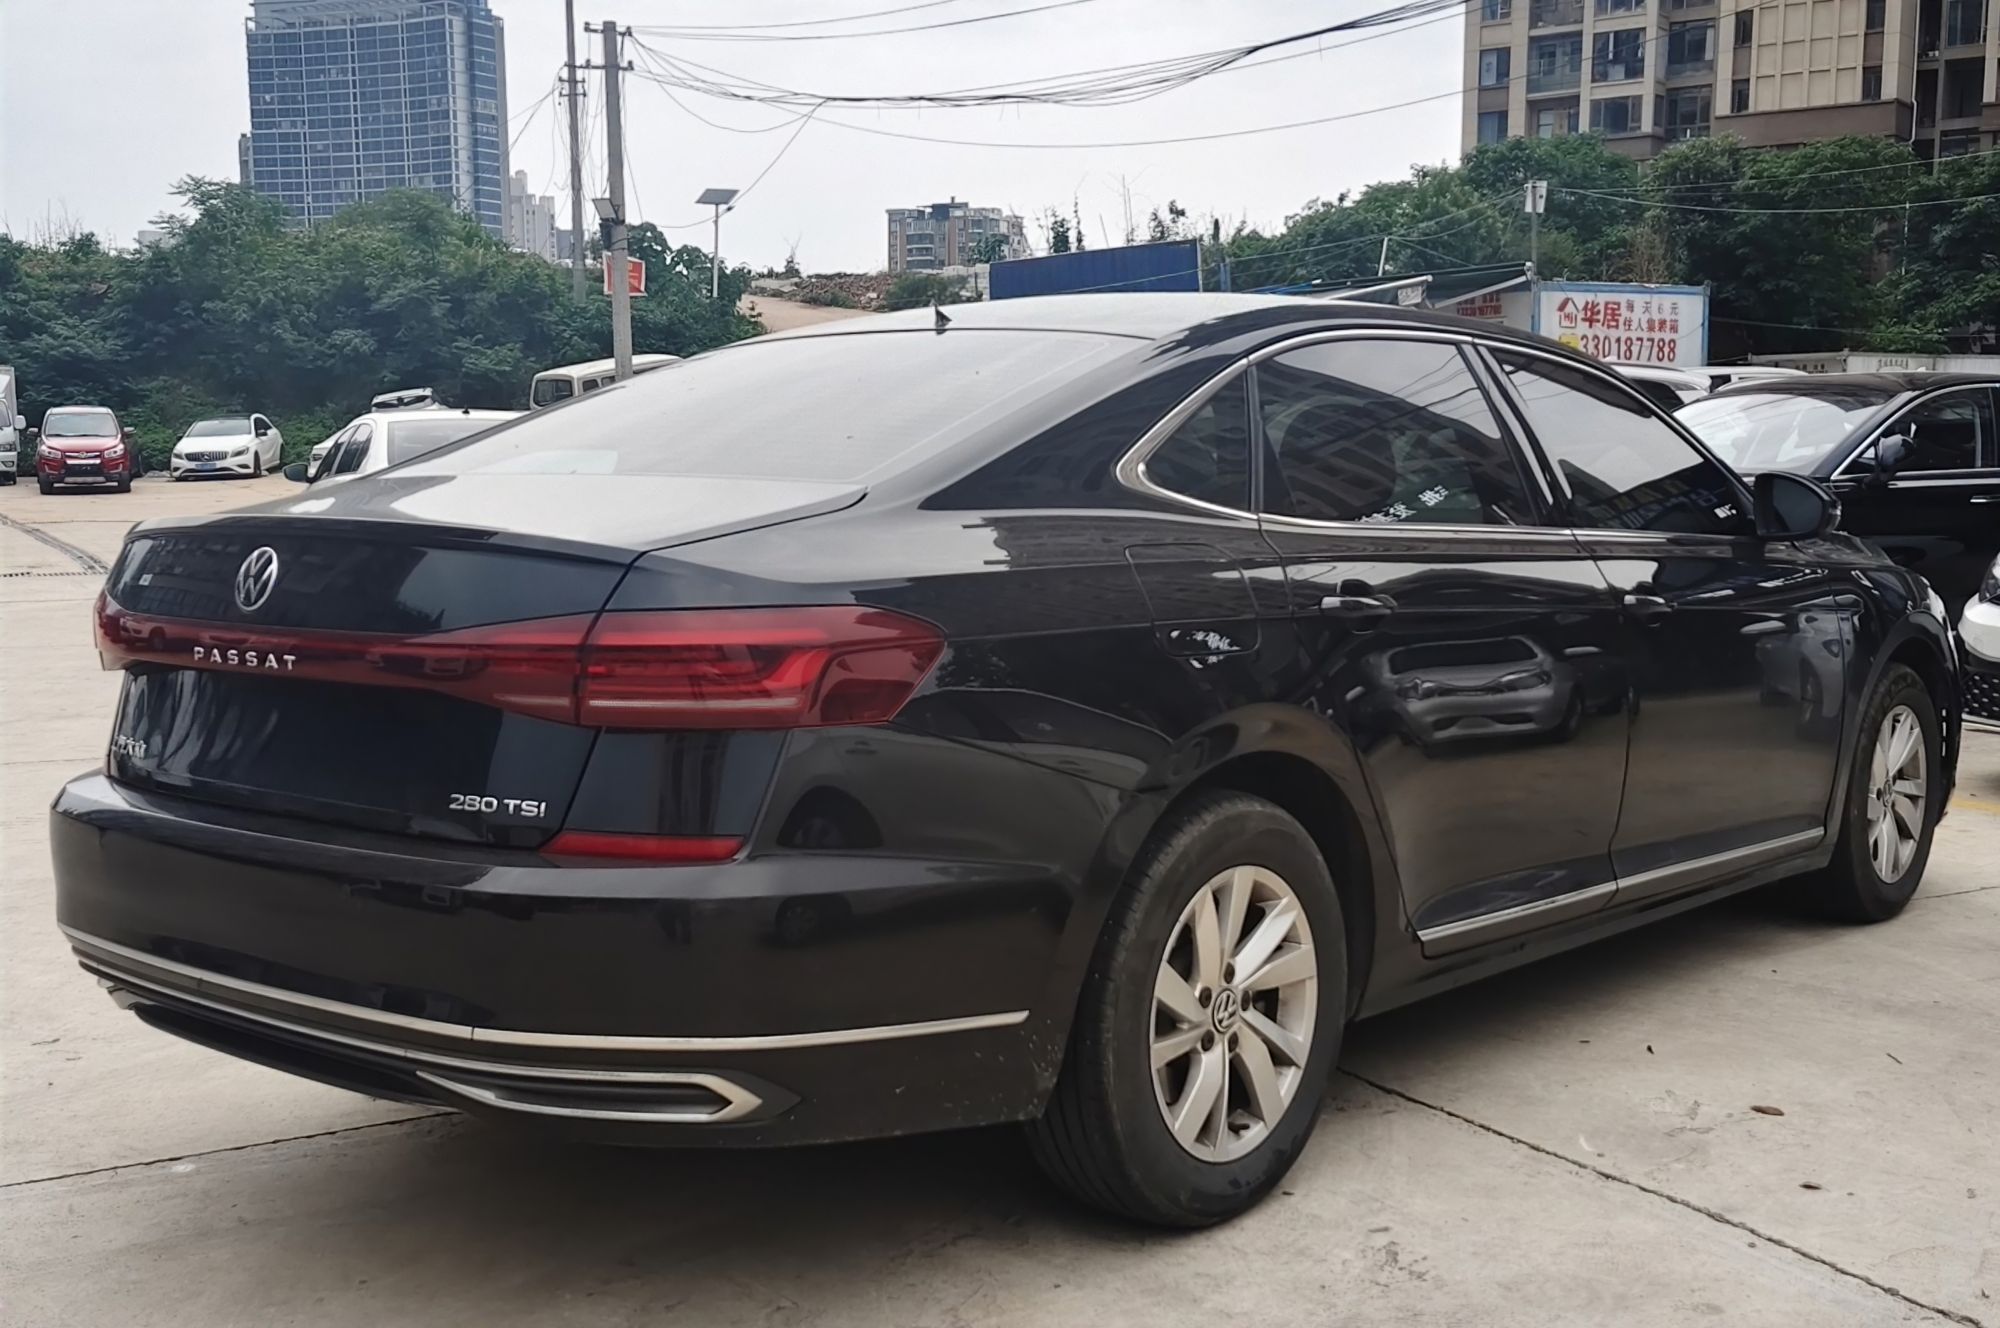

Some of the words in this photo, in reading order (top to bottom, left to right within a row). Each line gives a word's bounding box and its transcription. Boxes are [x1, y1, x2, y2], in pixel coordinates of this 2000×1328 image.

[1581, 300, 1622, 330] 华居
[1580, 334, 1677, 362] 330187788
[193, 646, 296, 670] PASSAT
[449, 793, 498, 813] 280
[503, 799, 547, 818] TSI
